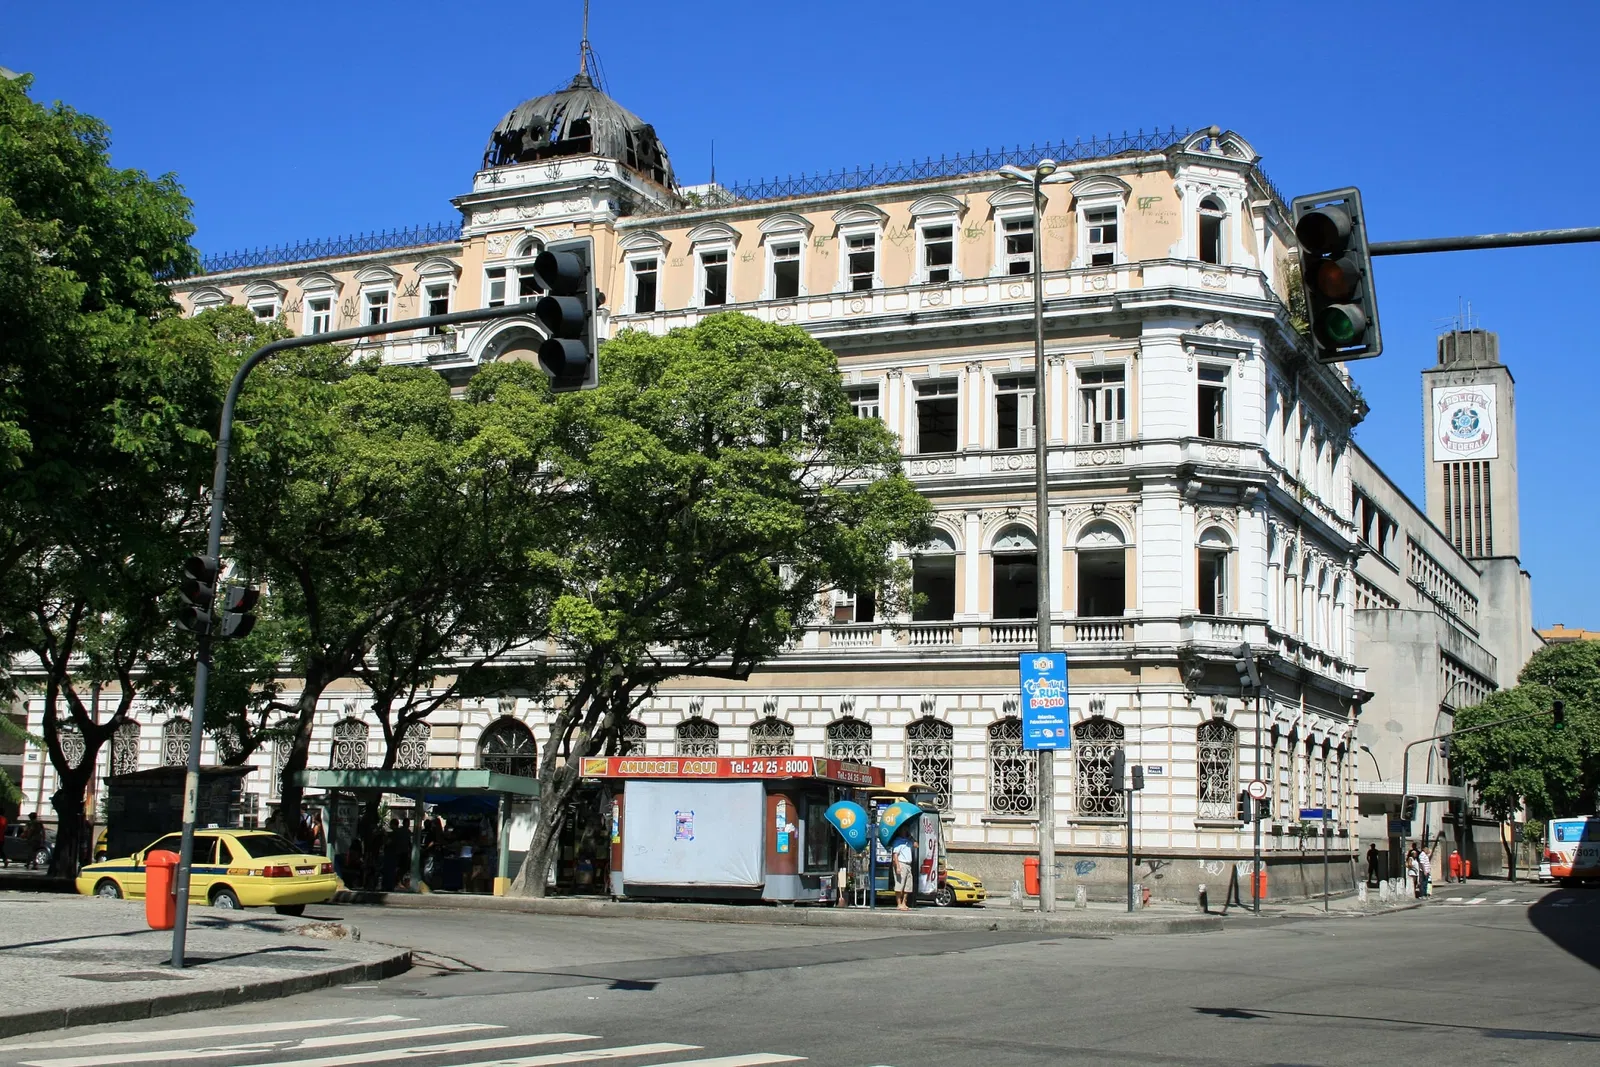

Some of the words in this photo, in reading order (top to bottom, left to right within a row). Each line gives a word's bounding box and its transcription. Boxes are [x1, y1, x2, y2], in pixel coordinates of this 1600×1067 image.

[1447, 440, 1484, 451] FEDERAL
[1039, 688, 1059, 698] RUA
[1044, 697, 1064, 708] 2010
[618, 761, 679, 773] ANUNCIE
[682, 761, 717, 773] AQUI
[730, 761, 750, 773] Tel.:
[752, 761, 763, 773] 24
[766, 761, 777, 773] 25
[785, 760, 809, 773] 8000
[1571, 849, 1599, 857] 73021
